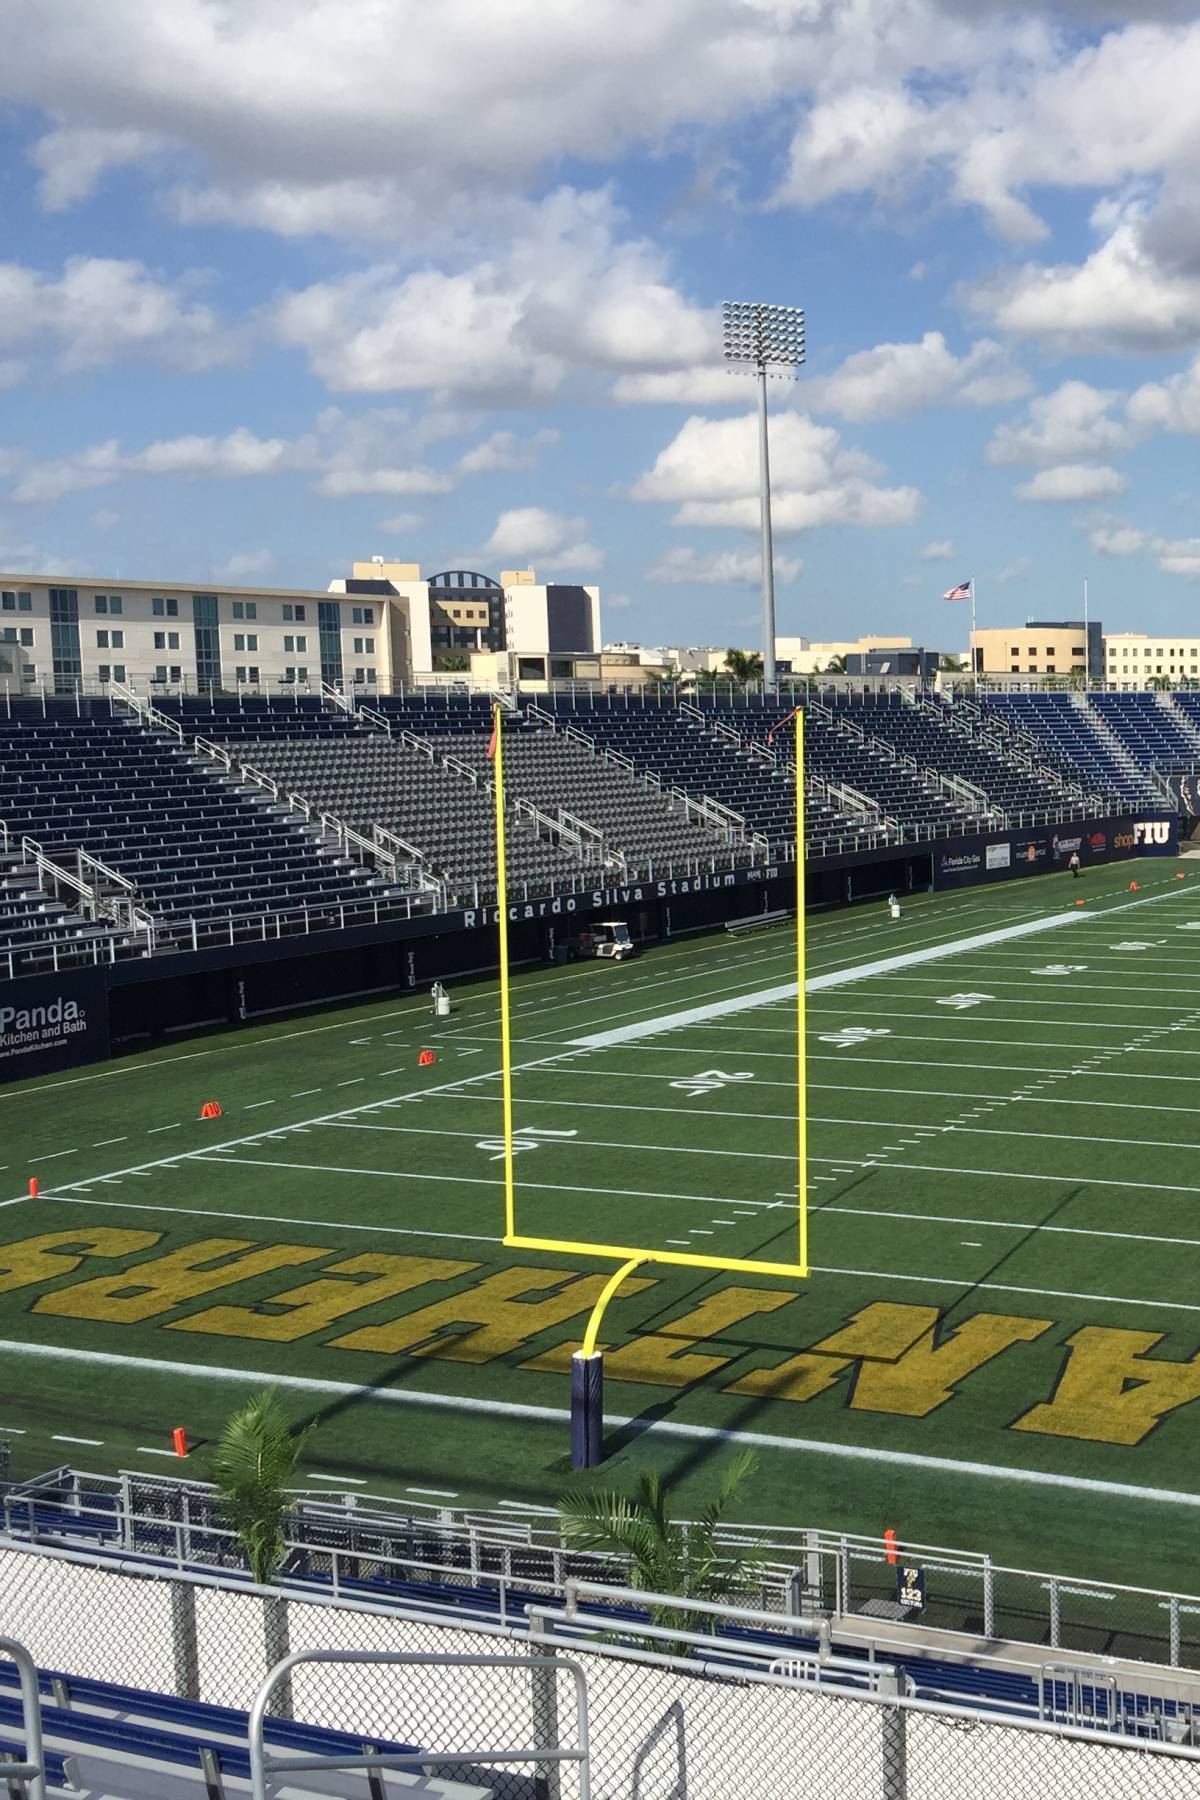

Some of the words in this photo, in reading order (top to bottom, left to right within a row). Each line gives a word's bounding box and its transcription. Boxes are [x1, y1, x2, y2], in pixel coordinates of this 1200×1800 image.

[766, 867, 778, 879] FIU
[464, 898, 577, 928] Riccardo
[592, 887, 643, 907] Silva
[657, 873, 736, 898] Stadium
[0, 997, 79, 1034] Panda
[0, 1030, 40, 1047] Kitchen
[41, 1023, 61, 1039] and
[62, 1018, 87, 1034] Bath
[900, 1586, 922, 1602] 123
